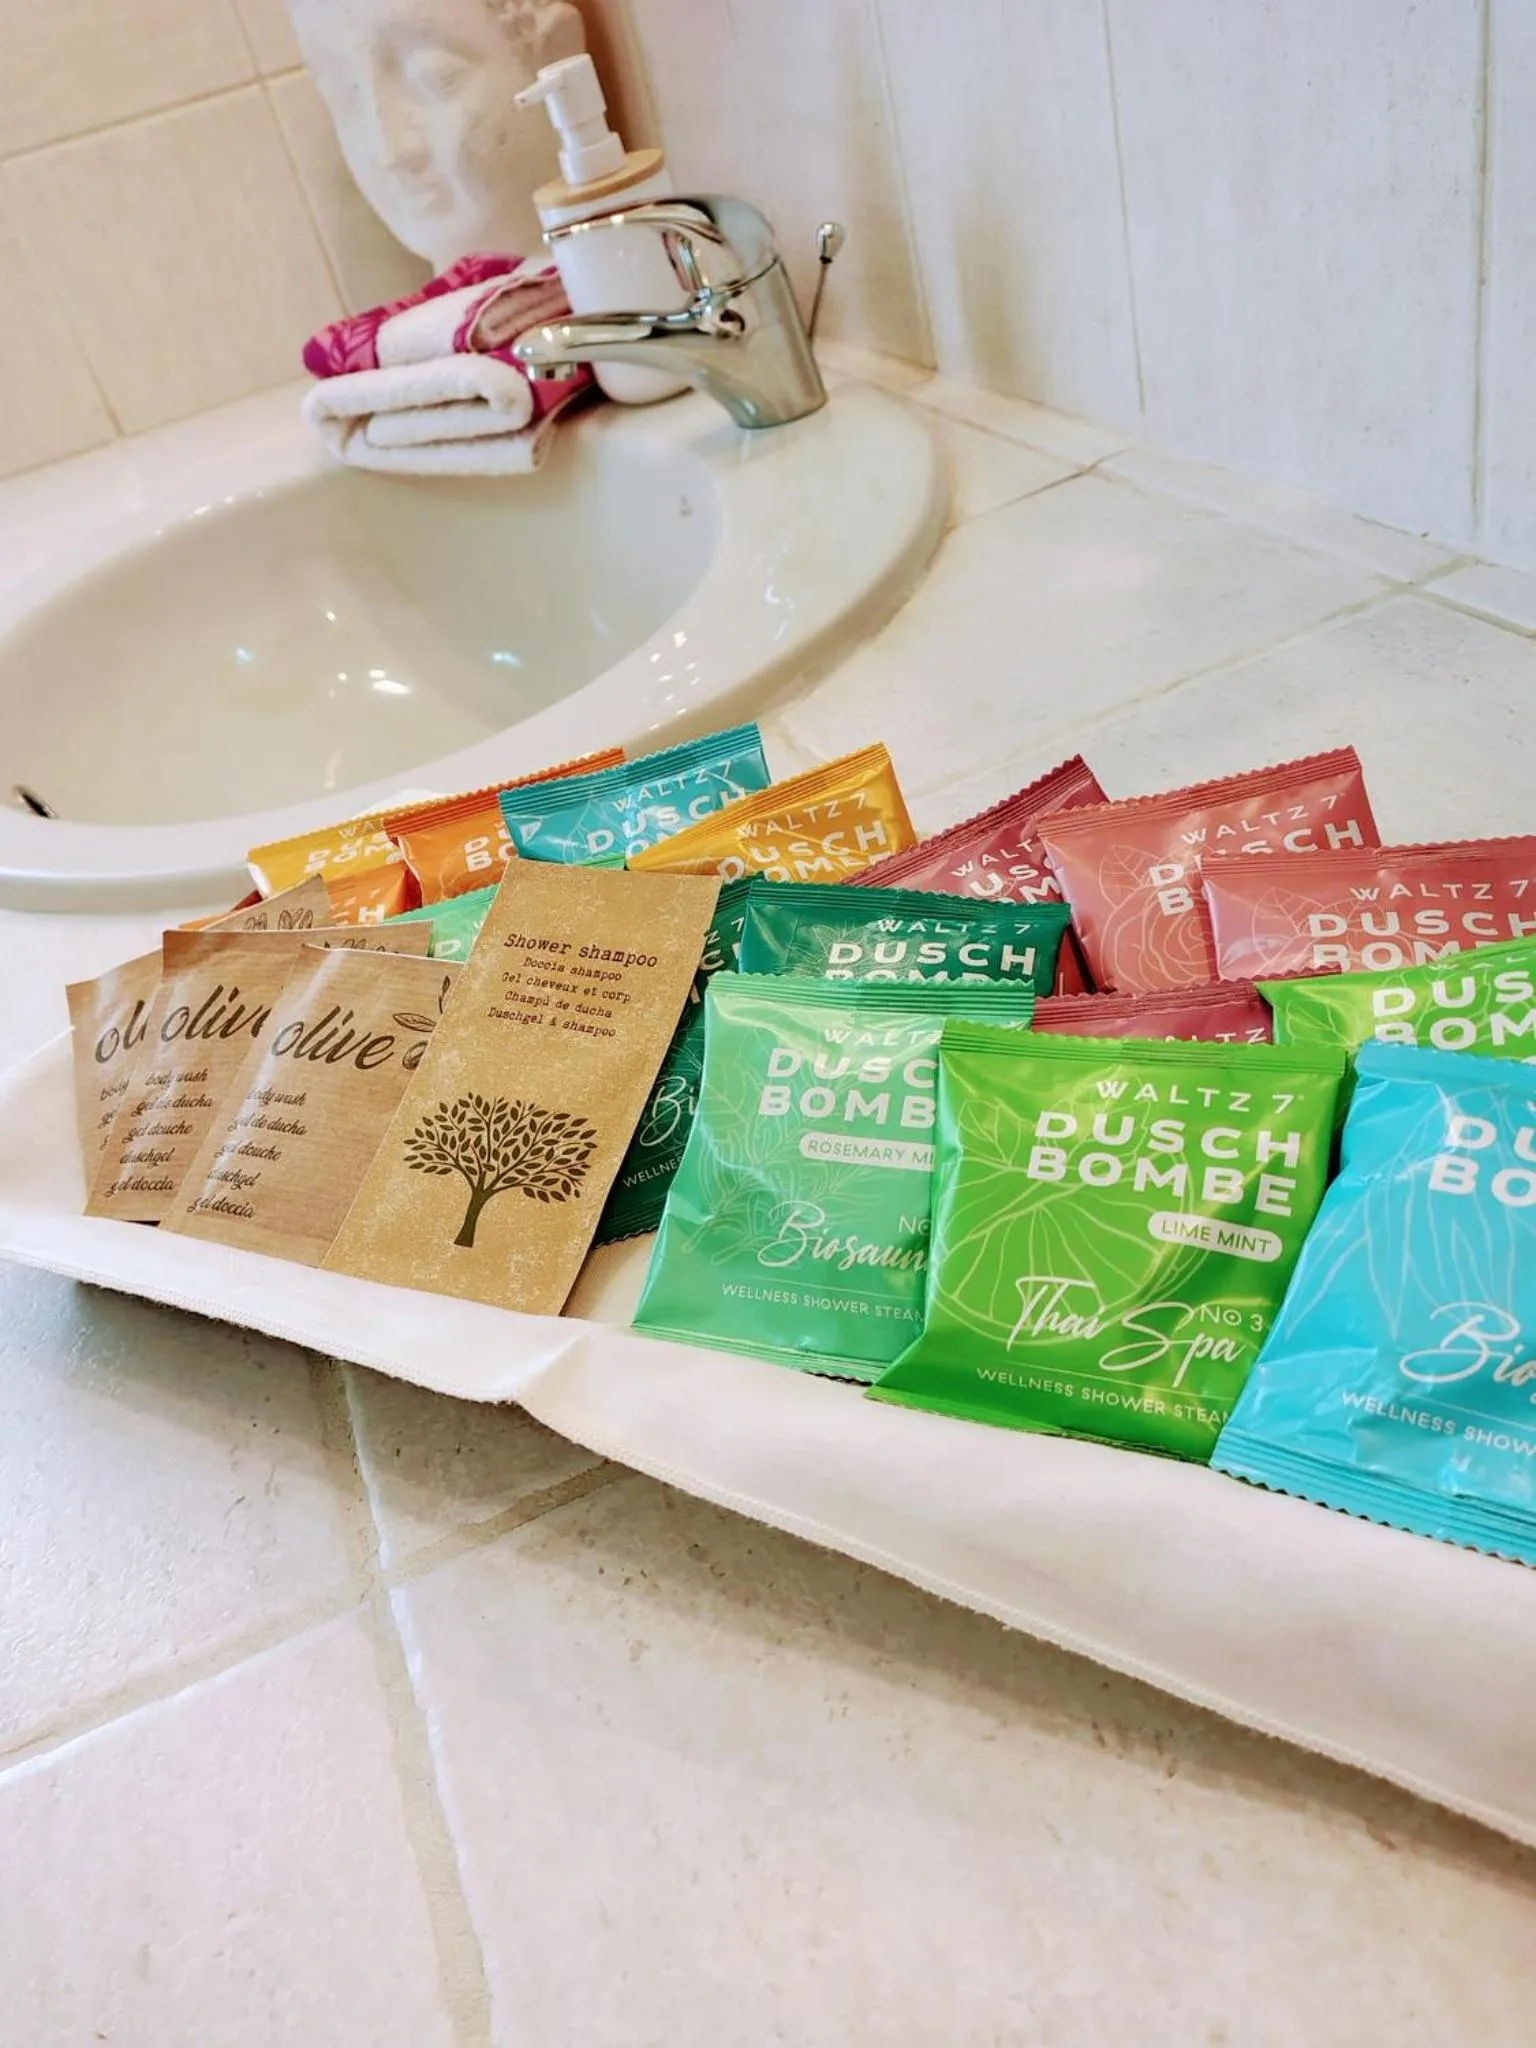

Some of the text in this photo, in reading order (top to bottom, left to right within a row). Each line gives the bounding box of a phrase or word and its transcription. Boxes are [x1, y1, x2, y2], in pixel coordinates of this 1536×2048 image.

[612, 769, 709, 813] WALTZ
[736, 792, 867, 839] WALTZ 7
[1180, 794, 1339, 847] WALTZ 7
[1350, 879, 1529, 901] WALTZ 7
[876, 918, 1034, 935] WALTZ 7
[503, 932, 659, 968] Shower shampoo
[827, 942, 1036, 976] DUSCH
[523, 956, 622, 982] Doccia shampoo
[501, 971, 632, 1005] Gel cheveux et corp
[487, 1006, 617, 1038] Duschgel & shampoo
[555, 998, 571, 1011] de
[574, 1002, 613, 1019] ducha
[271, 1006, 396, 1071] olive
[171, 1093, 214, 1109] ducha
[1096, 1080, 1295, 1115] WALTZ 7
[147, 1120, 194, 1137] douche
[266, 1117, 308, 1136] ducha
[1034, 1110, 1302, 1169] DUSCH
[119, 1147, 176, 1169] duschgel
[237, 1141, 283, 1161] douche
[807, 1138, 907, 1164] ROSEMARY
[130, 1176, 175, 1192] doccia
[1026, 1145, 1298, 1217] BOMBE
[211, 1195, 256, 1219] doccia
[1160, 1220, 1273, 1255] LIME MINT
[720, 1282, 799, 1307] WELLNESS
[803, 1294, 869, 1316] SHOWER
[1006, 1275, 1247, 1389] Thai Spa
[1250, 1313, 1264, 1332] 3
[976, 1367, 1075, 1399] WELLNESS
[1080, 1386, 1166, 1417] SHOWER
[1341, 1390, 1457, 1436] WELLNESS
